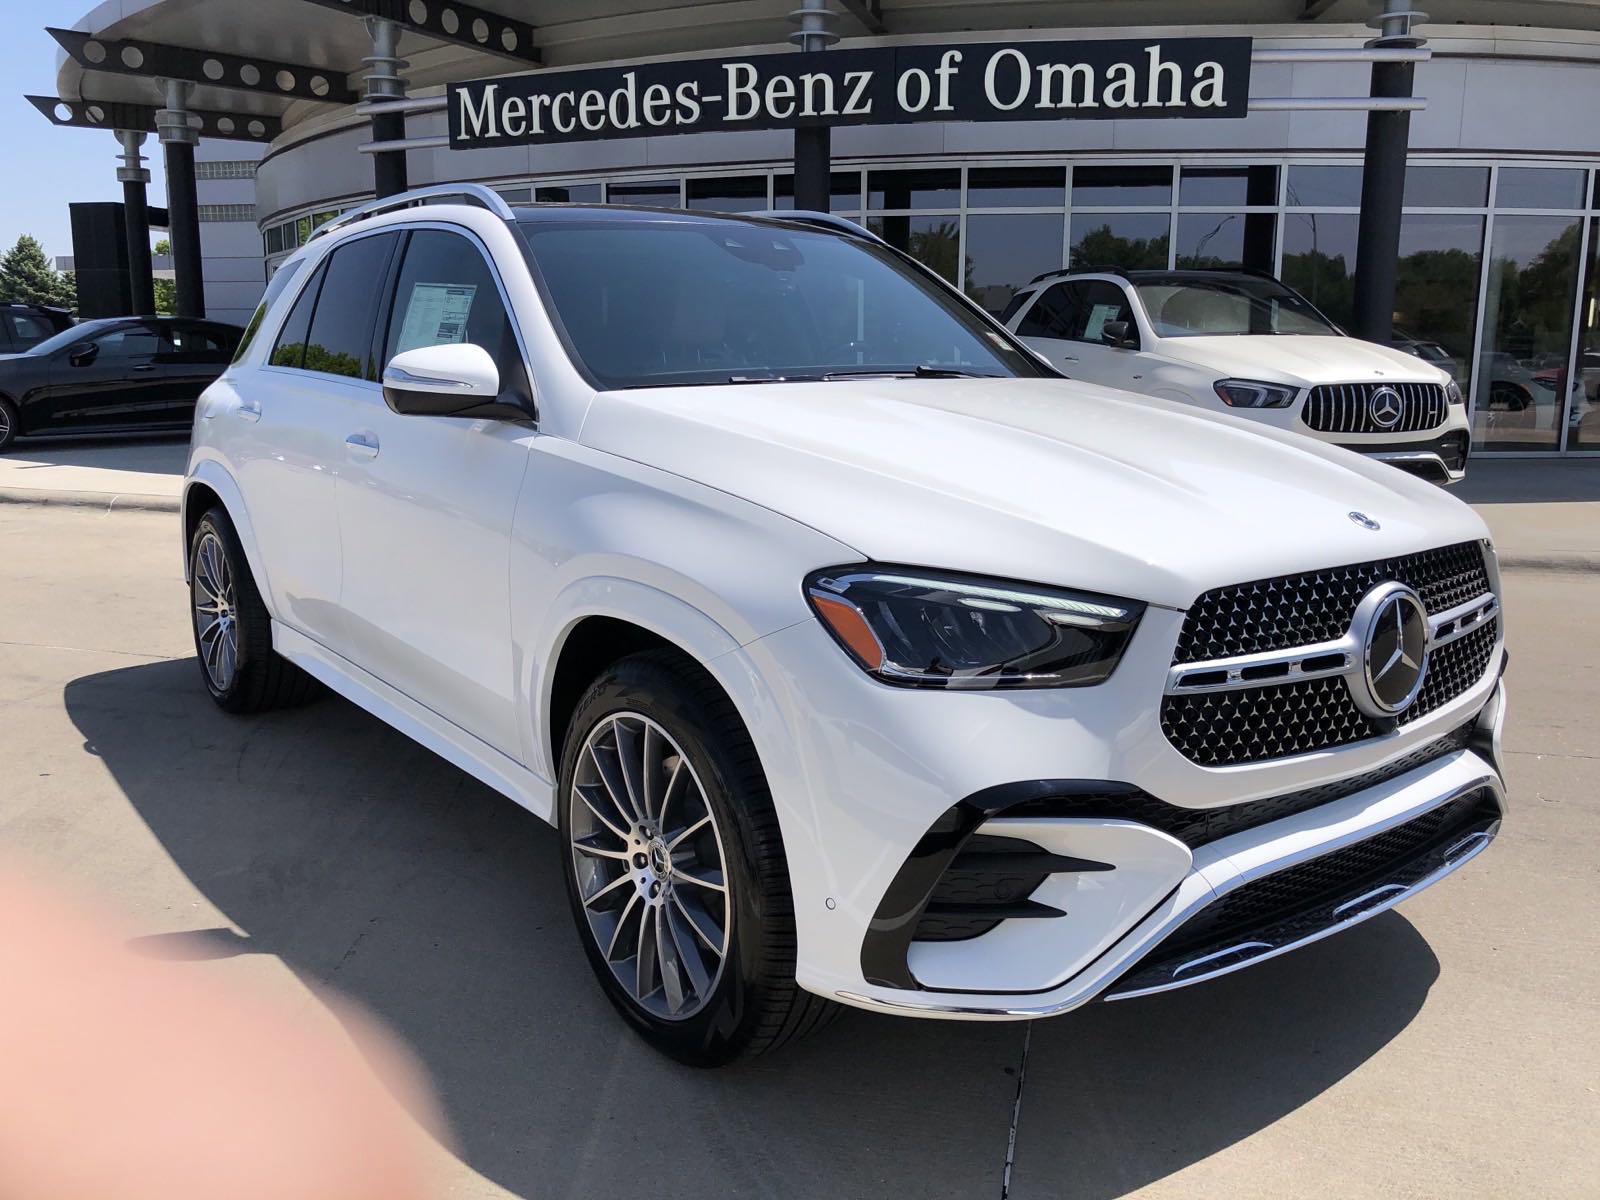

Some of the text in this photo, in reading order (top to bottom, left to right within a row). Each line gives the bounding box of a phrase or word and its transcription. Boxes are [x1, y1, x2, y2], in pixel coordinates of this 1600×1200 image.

[455, 44, 1228, 140] Mercedes-Benz of Omaha
